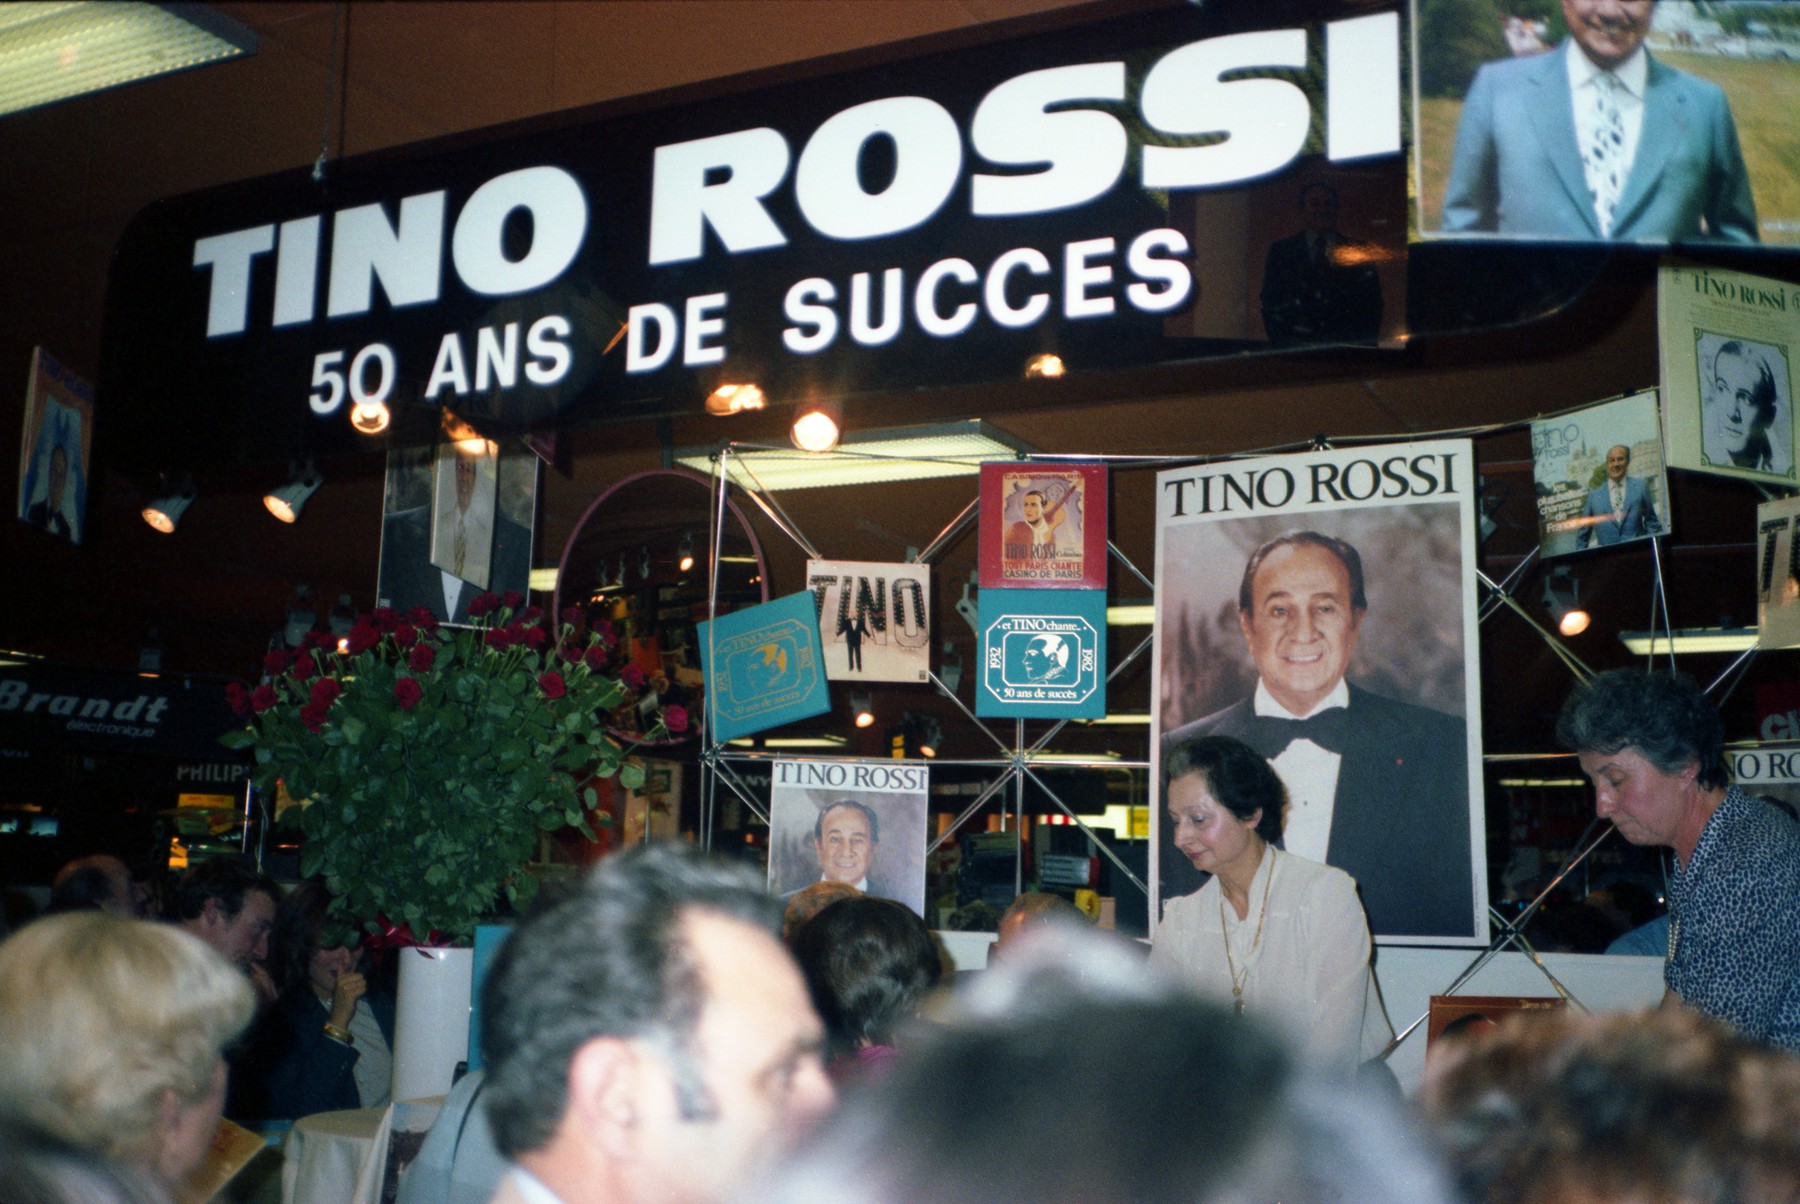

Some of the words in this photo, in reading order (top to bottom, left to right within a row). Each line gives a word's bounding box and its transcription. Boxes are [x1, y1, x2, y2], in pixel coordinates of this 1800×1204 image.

[193, 165, 588, 338] TINO
[649, 11, 1401, 264] ROSSI
[309, 343, 395, 416] 50
[424, 315, 572, 398] ANS
[625, 292, 727, 372] DE
[783, 228, 1192, 353] SUCCES
[1164, 467, 1296, 517] TINO
[1306, 453, 1460, 504] ROSSI
[1540, 499, 1581, 515] chansons
[1005, 543, 1027, 559] TINO
[1004, 570, 1038, 579] CASINO
[1040, 570, 1052, 579] DE
[1054, 570, 1082, 579] PARIS
[1025, 561, 1048, 570] PARIS
[1050, 561, 1082, 570] CHANTE
[808, 575, 929, 648] TINO
[1001, 622, 1011, 630] et
[1011, 618, 1046, 631] TINO
[989, 647, 1002, 669] 1932
[1081, 649, 1093, 672] 1982
[0, 679, 169, 723] Brandt
[1003, 688, 1015, 698] 50
[1016, 690, 1032, 698] ans
[1034, 688, 1046, 698] de
[1047, 689, 1077, 699] succès
[66, 718, 156, 738] électronique
[177, 764, 250, 783] PHILIP
[775, 762, 848, 787] TINO
[853, 765, 928, 790] ROSSI
[1768, 752, 1800, 778] RO
